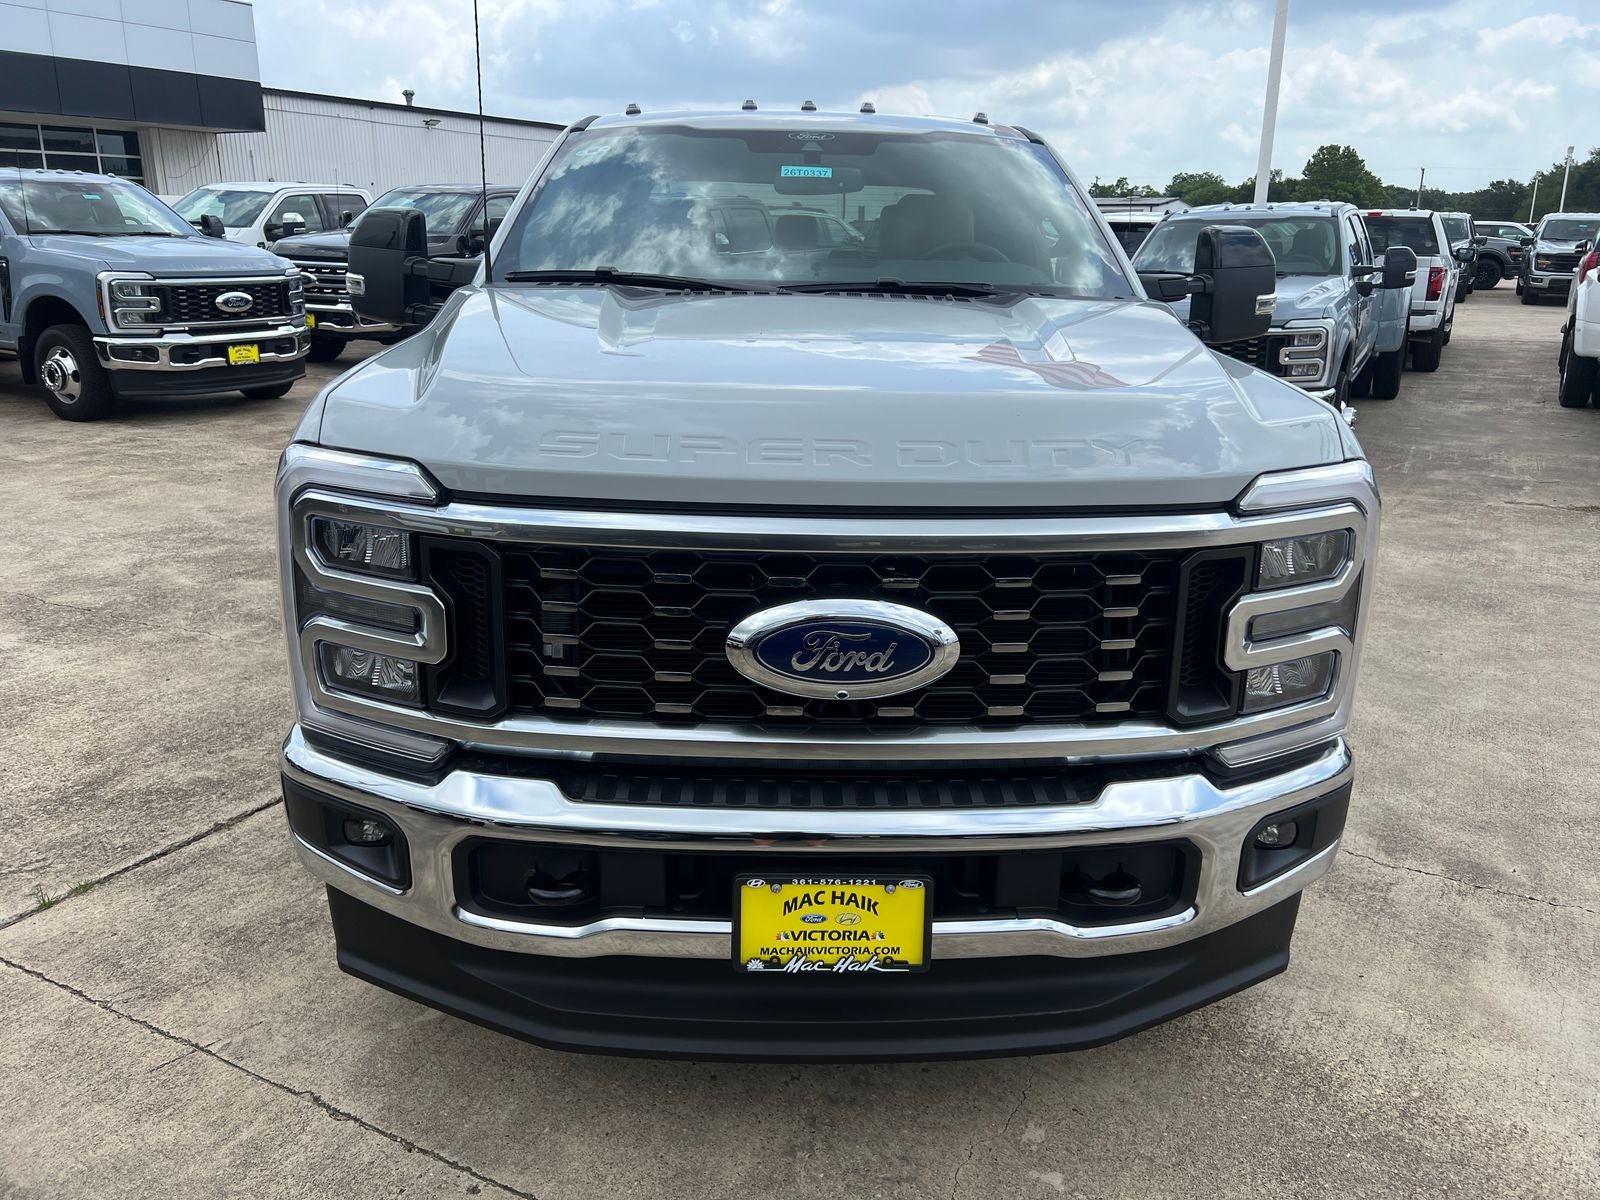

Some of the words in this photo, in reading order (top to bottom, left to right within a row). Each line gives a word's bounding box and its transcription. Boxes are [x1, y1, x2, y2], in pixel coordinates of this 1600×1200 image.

[783, 168, 828, 177] 26T0337
[539, 430, 872, 467] SUPER
[896, 438, 1146, 468] DUTY
[791, 630, 898, 672] Ford
[792, 878, 877, 886] 361-576-1221
[902, 879, 921, 889] Ford
[782, 890, 826, 916] MAC
[830, 890, 880, 916] HAIK
[790, 930, 871, 942] VICTORIA
[759, 946, 901, 955] MACHAIKVICTORIA.COM
[783, 955, 830, 973] Mac
[832, 955, 881, 973] Haik
